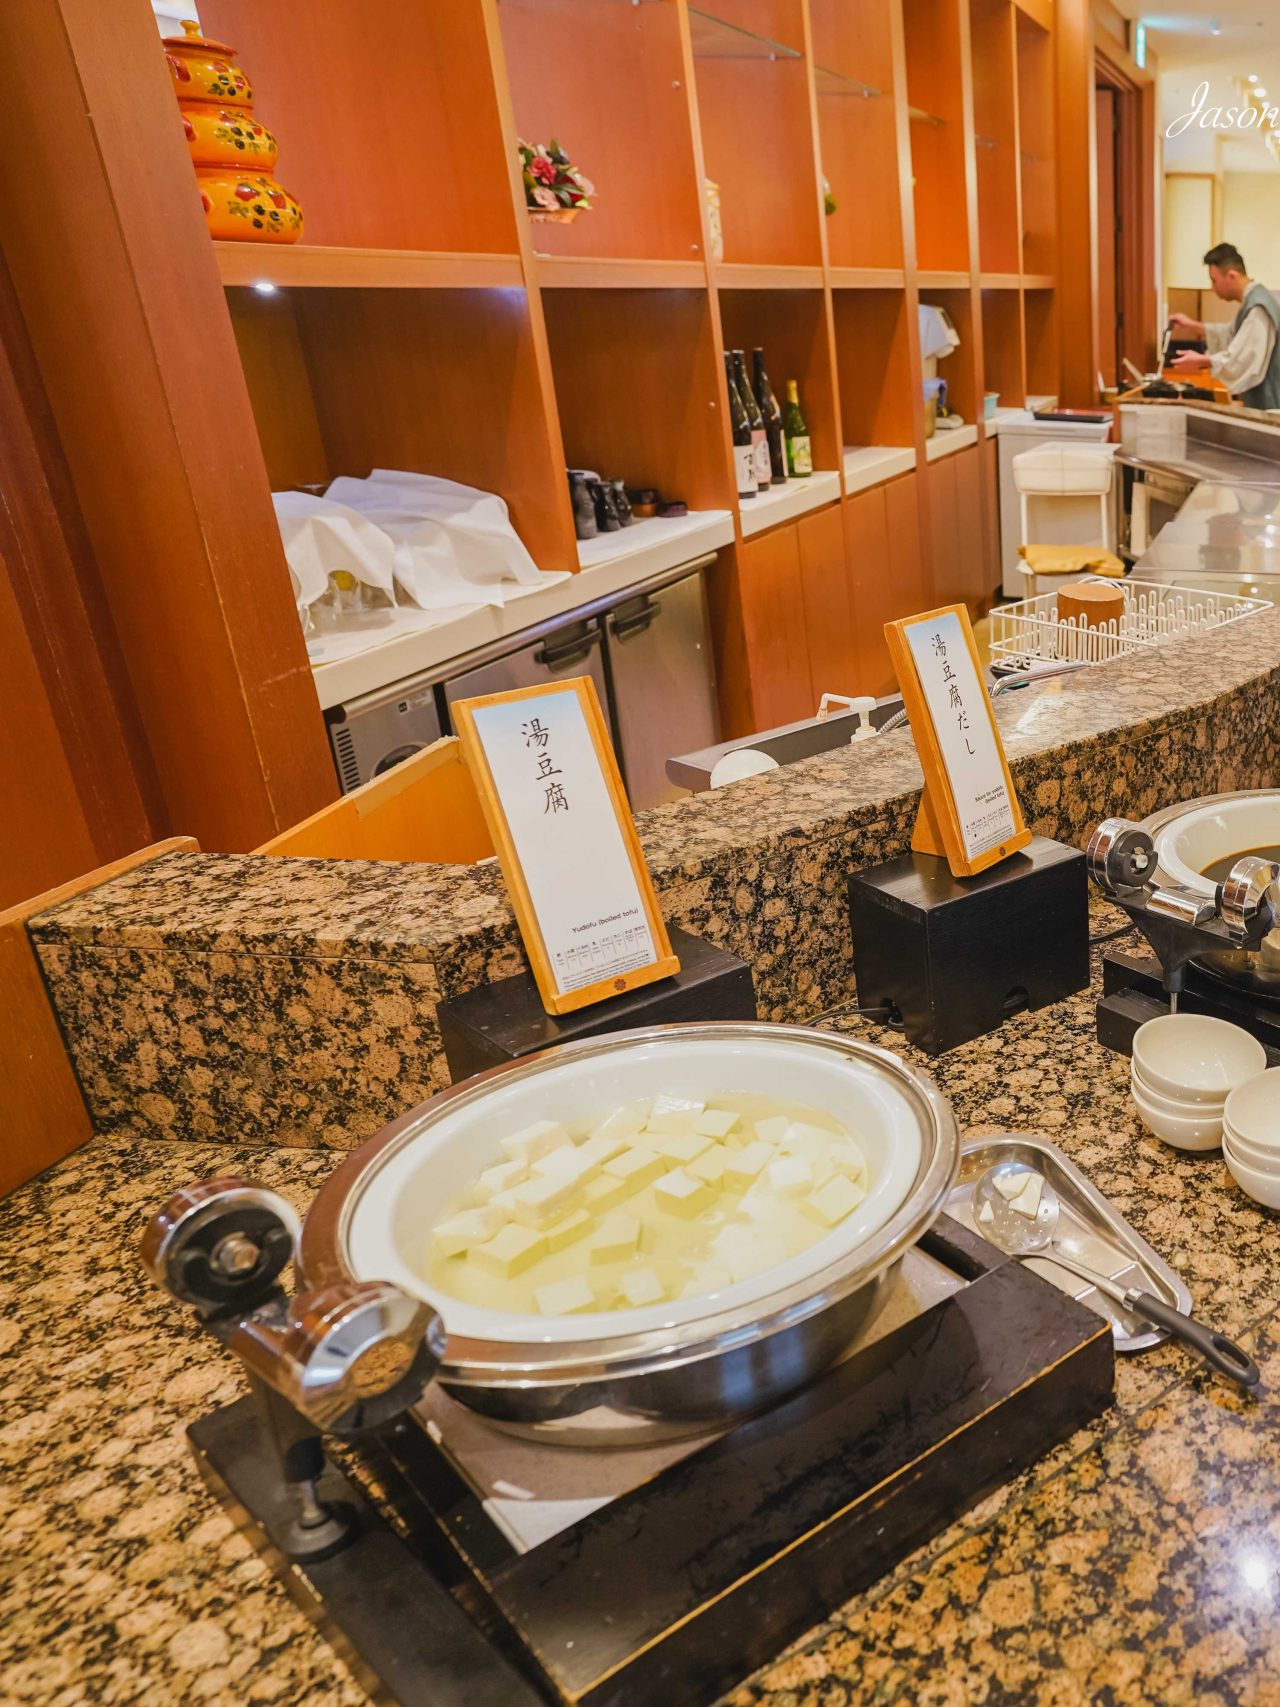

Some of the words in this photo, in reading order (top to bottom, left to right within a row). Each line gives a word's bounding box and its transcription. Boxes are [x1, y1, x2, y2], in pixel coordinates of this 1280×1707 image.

[931, 633, 976, 755] 湯豆腐だし
[521, 717, 569, 815] 湯豆腐
[572, 921, 597, 933] Yudofu
[598, 913, 621, 925] (boiled
[622, 907, 639, 917] tofu)
